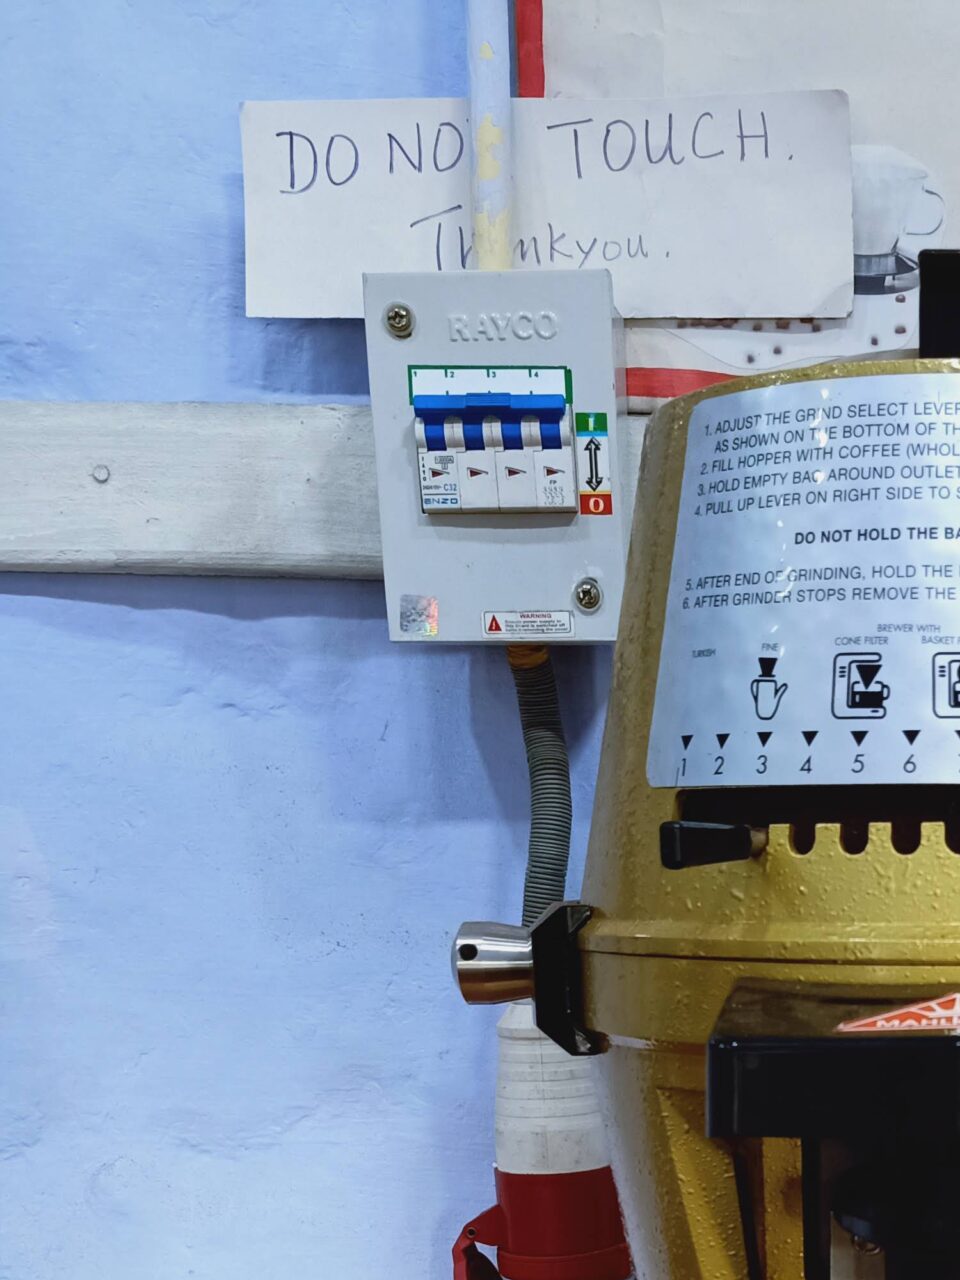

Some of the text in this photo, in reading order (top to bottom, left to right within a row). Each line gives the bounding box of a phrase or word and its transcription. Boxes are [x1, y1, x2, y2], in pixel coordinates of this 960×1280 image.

[276, 130, 359, 194] DO
[388, 114, 470, 174] NO
[448, 310, 559, 342] RAYCO
[704, 425, 713, 436] 1.
[715, 414, 761, 434] ADJUST
[764, 411, 791, 425] THE
[796, 406, 842, 423] GRND
[848, 403, 908, 417] SELECT
[714, 440, 729, 454] AS
[732, 432, 779, 450] SHOWN
[784, 430, 804, 444] ON
[843, 423, 910, 438] BOTTOM
[915, 422, 936, 435] OF
[700, 463, 709, 475] 2.
[712, 459, 733, 473] FILL
[738, 450, 791, 469] HOPPER
[796, 447, 833, 462] WITH
[838, 443, 901, 459] COFFEE
[697, 483, 706, 497] 3.
[709, 479, 740, 493] HOLD
[744, 472, 788, 490] EMPTY
[827, 465, 895, 482] AROUND
[694, 505, 703, 516] 4.
[706, 500, 733, 516] PULL
[738, 498, 754, 511] UP
[758, 491, 801, 509] LEVER
[806, 491, 827, 504] ON
[833, 488, 880, 503] RIGHT
[886, 486, 923, 500] SIDE
[930, 486, 951, 500] TO
[794, 531, 815, 545] DO
[821, 529, 852, 543] NOT
[857, 528, 901, 542] HOLD
[907, 527, 939, 540] THE
[685, 579, 694, 591] 5.
[696, 574, 731, 589] AFTER
[734, 572, 760, 586] END
[788, 566, 866, 582] GRINDING,
[872, 565, 916, 578] HOLD
[923, 565, 953, 578] THE
[682, 597, 691, 609] 6.
[694, 594, 729, 609] AFTER
[732, 590, 791, 607] GRINDER
[796, 588, 846, 602] STOPS
[852, 586, 919, 601] REMOVE
[927, 586, 956, 599] THE
[835, 636, 889, 646] CONE FILTER
[877, 624, 941, 633] BREWER WITH
[921, 636, 954, 645] BASKET
[762, 643, 779, 652] FINE
[681, 758, 687, 776] 1
[713, 756, 725, 776] 2
[756, 755, 768, 774] 3
[799, 755, 813, 774] 4
[851, 754, 865, 773] 5
[903, 754, 917, 773] 6
